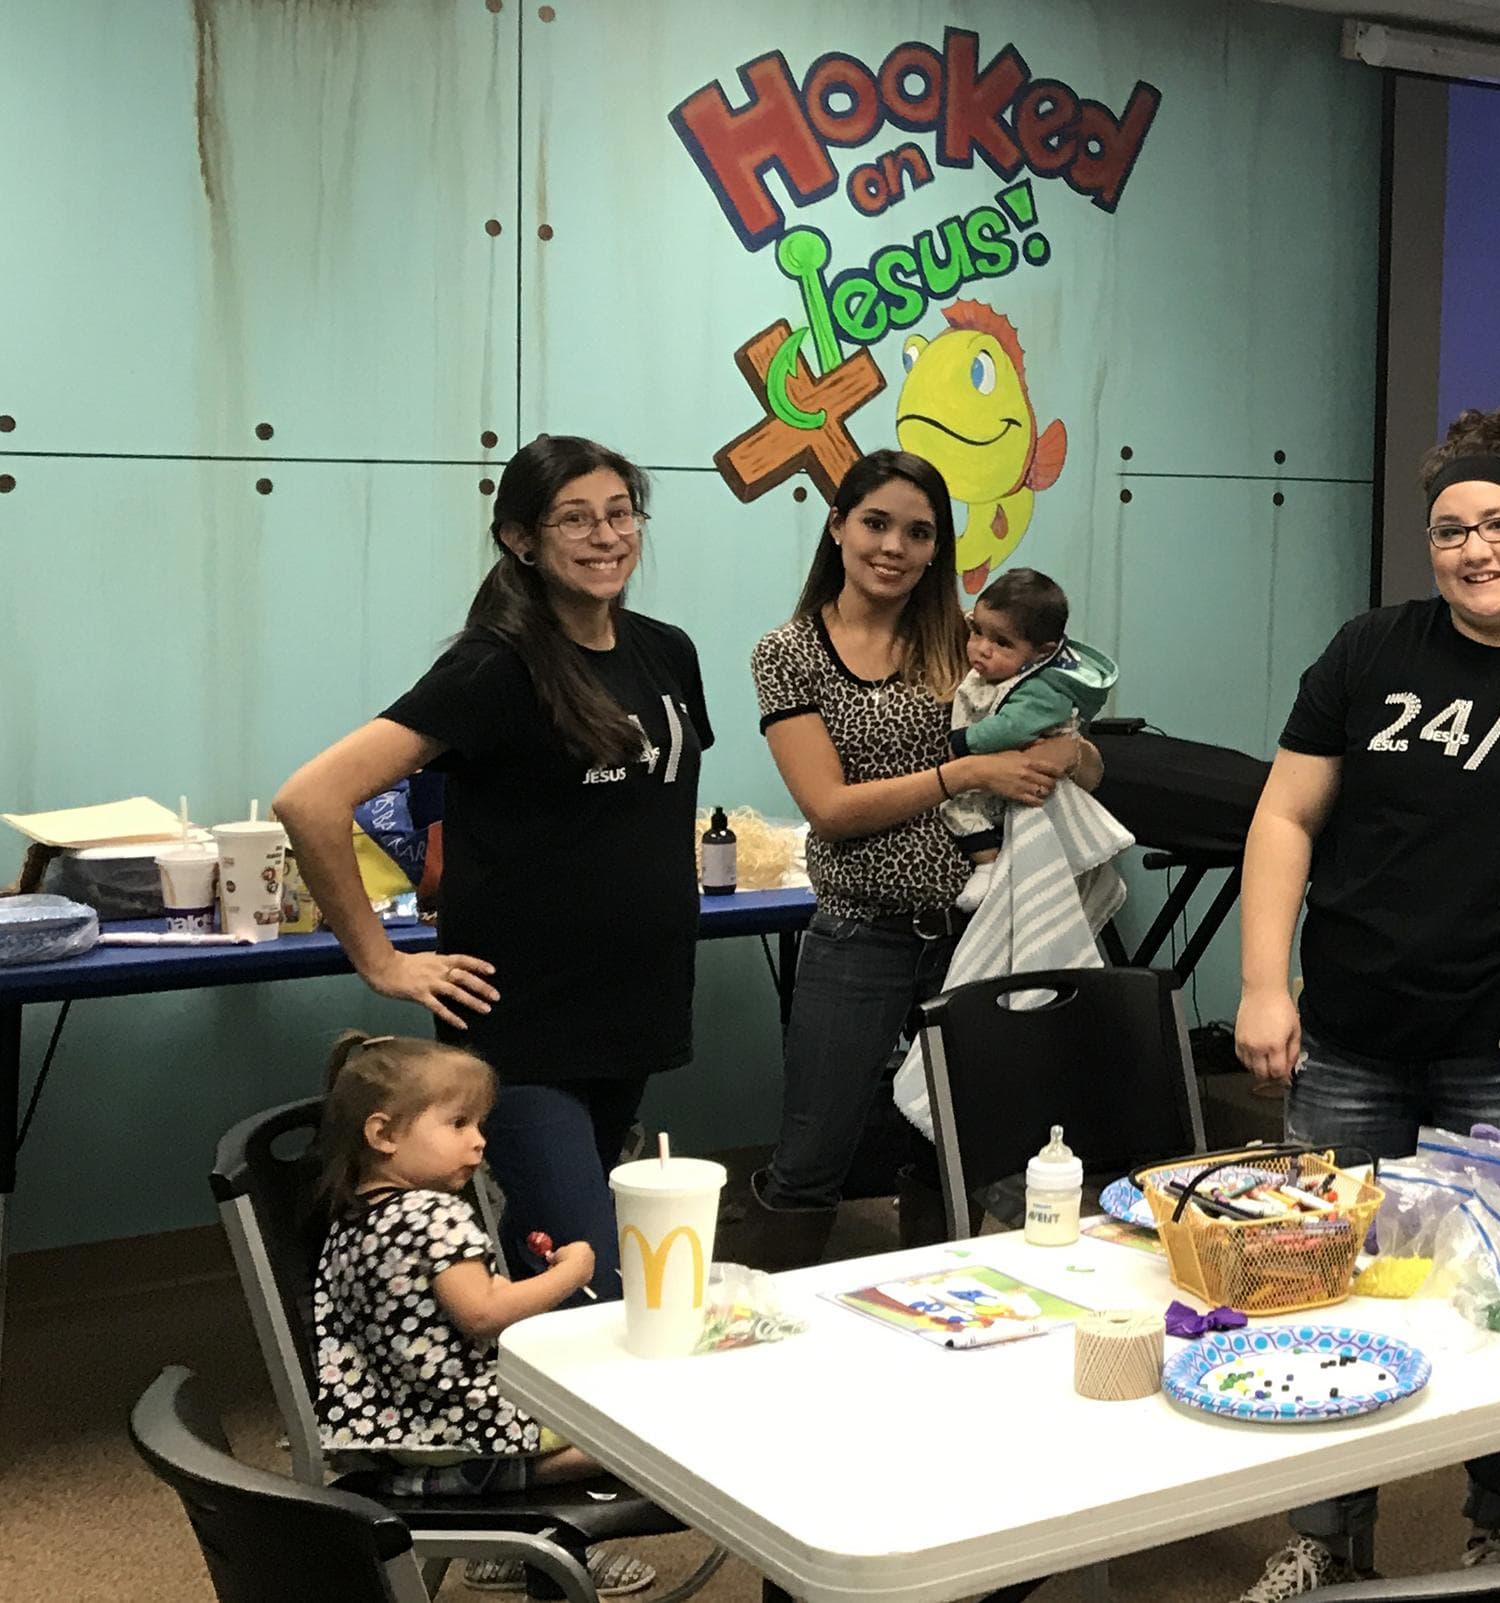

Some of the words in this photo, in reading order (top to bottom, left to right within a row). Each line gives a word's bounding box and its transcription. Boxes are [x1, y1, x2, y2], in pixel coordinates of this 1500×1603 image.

[846, 142, 935, 218] on
[1367, 738, 1409, 752] JESUS
[582, 767, 626, 784] JESUS
